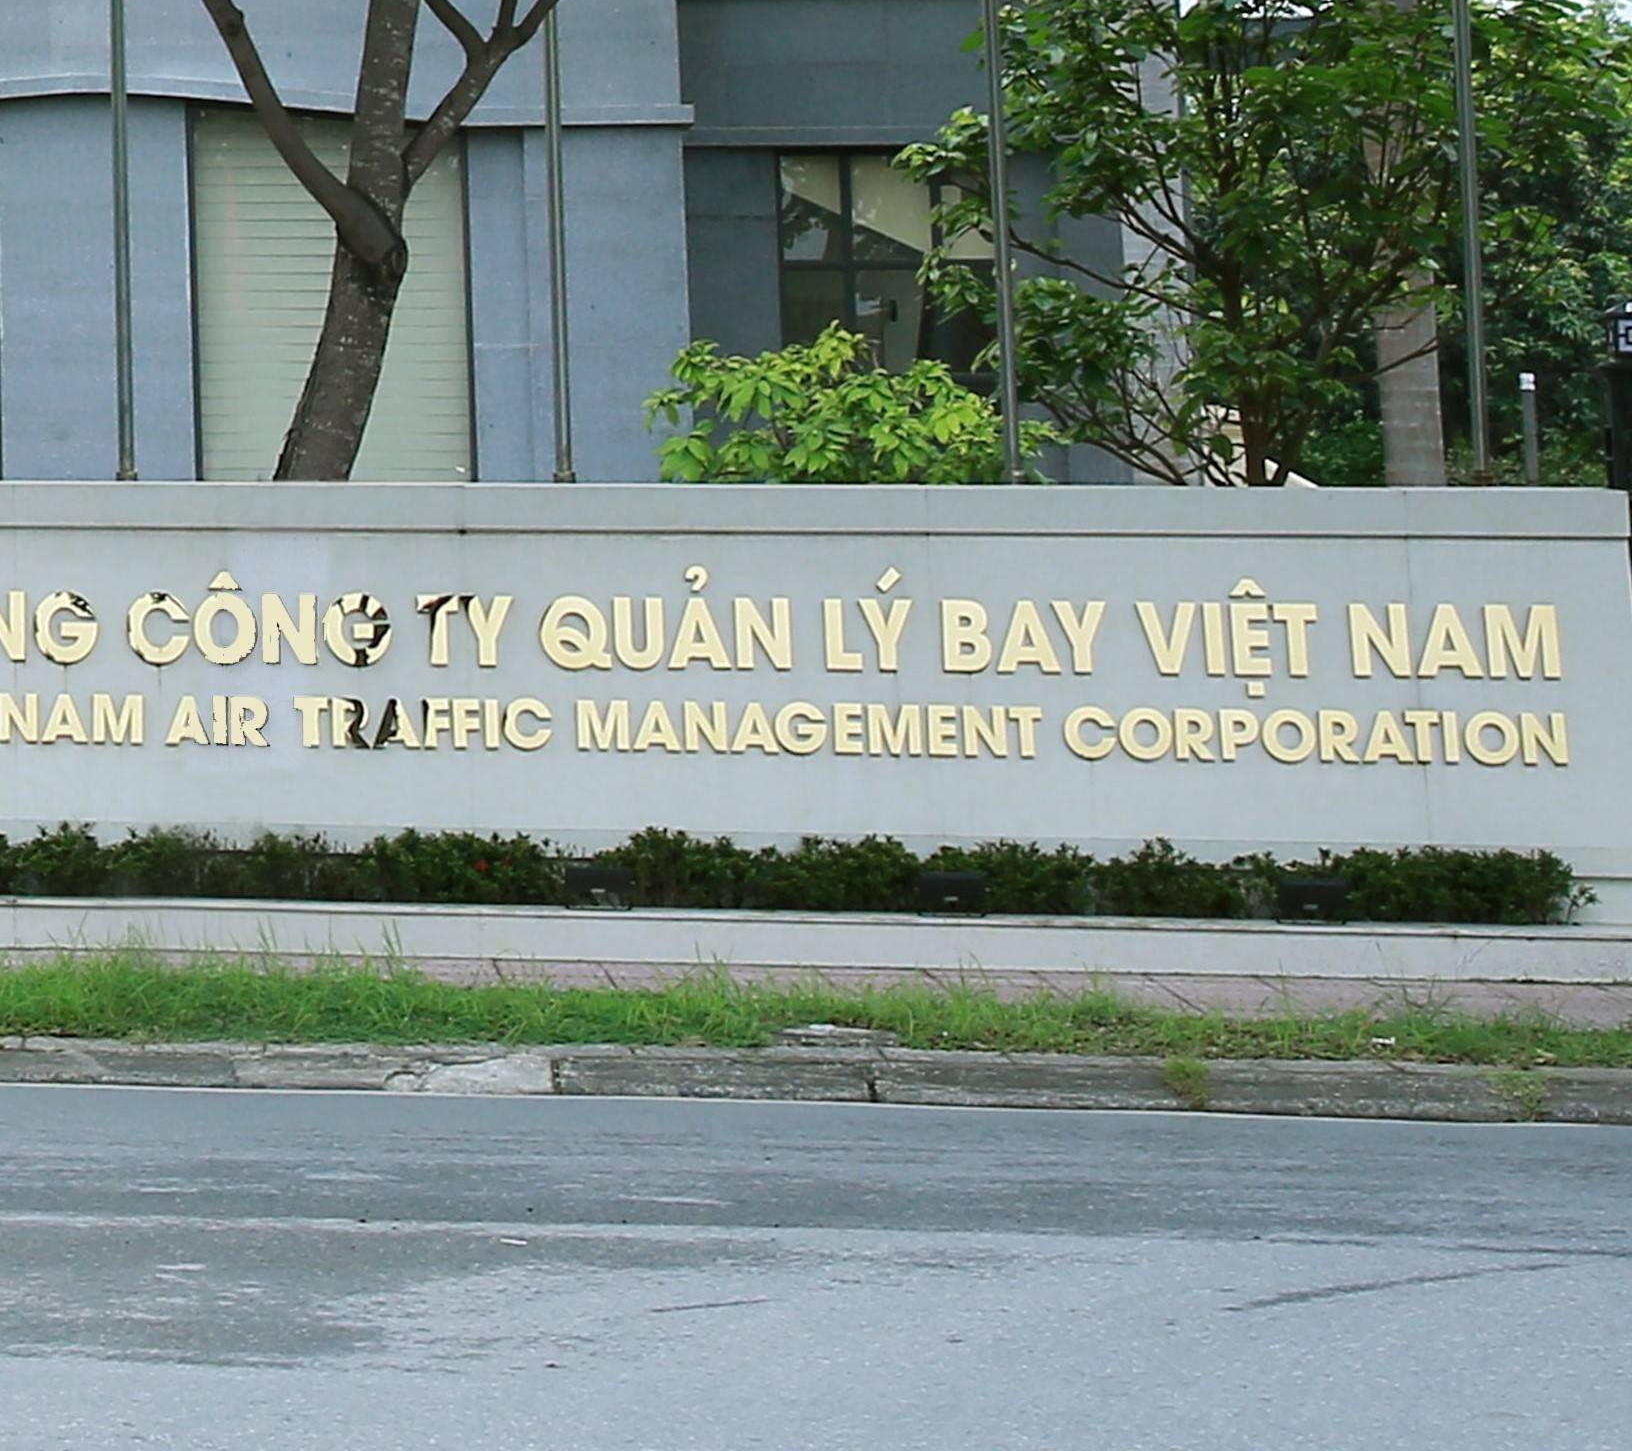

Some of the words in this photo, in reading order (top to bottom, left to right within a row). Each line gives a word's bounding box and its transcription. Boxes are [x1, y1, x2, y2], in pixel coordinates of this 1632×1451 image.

[127, 571, 393, 667] CÔNG
[414, 592, 513, 668] TY
[539, 566, 791, 672] QUẢN
[825, 567, 913, 672] LÝ
[941, 599, 1106, 675] BAY
[1135, 579, 1317, 696] VIỆT
[1349, 603, 1562, 680] NAM
[166, 694, 270, 748] AIR
[293, 696, 553, 750] TRAFFIC
[578, 698, 1042, 758] MANAGEMENT
[1064, 706, 1568, 765] CORPORATION
